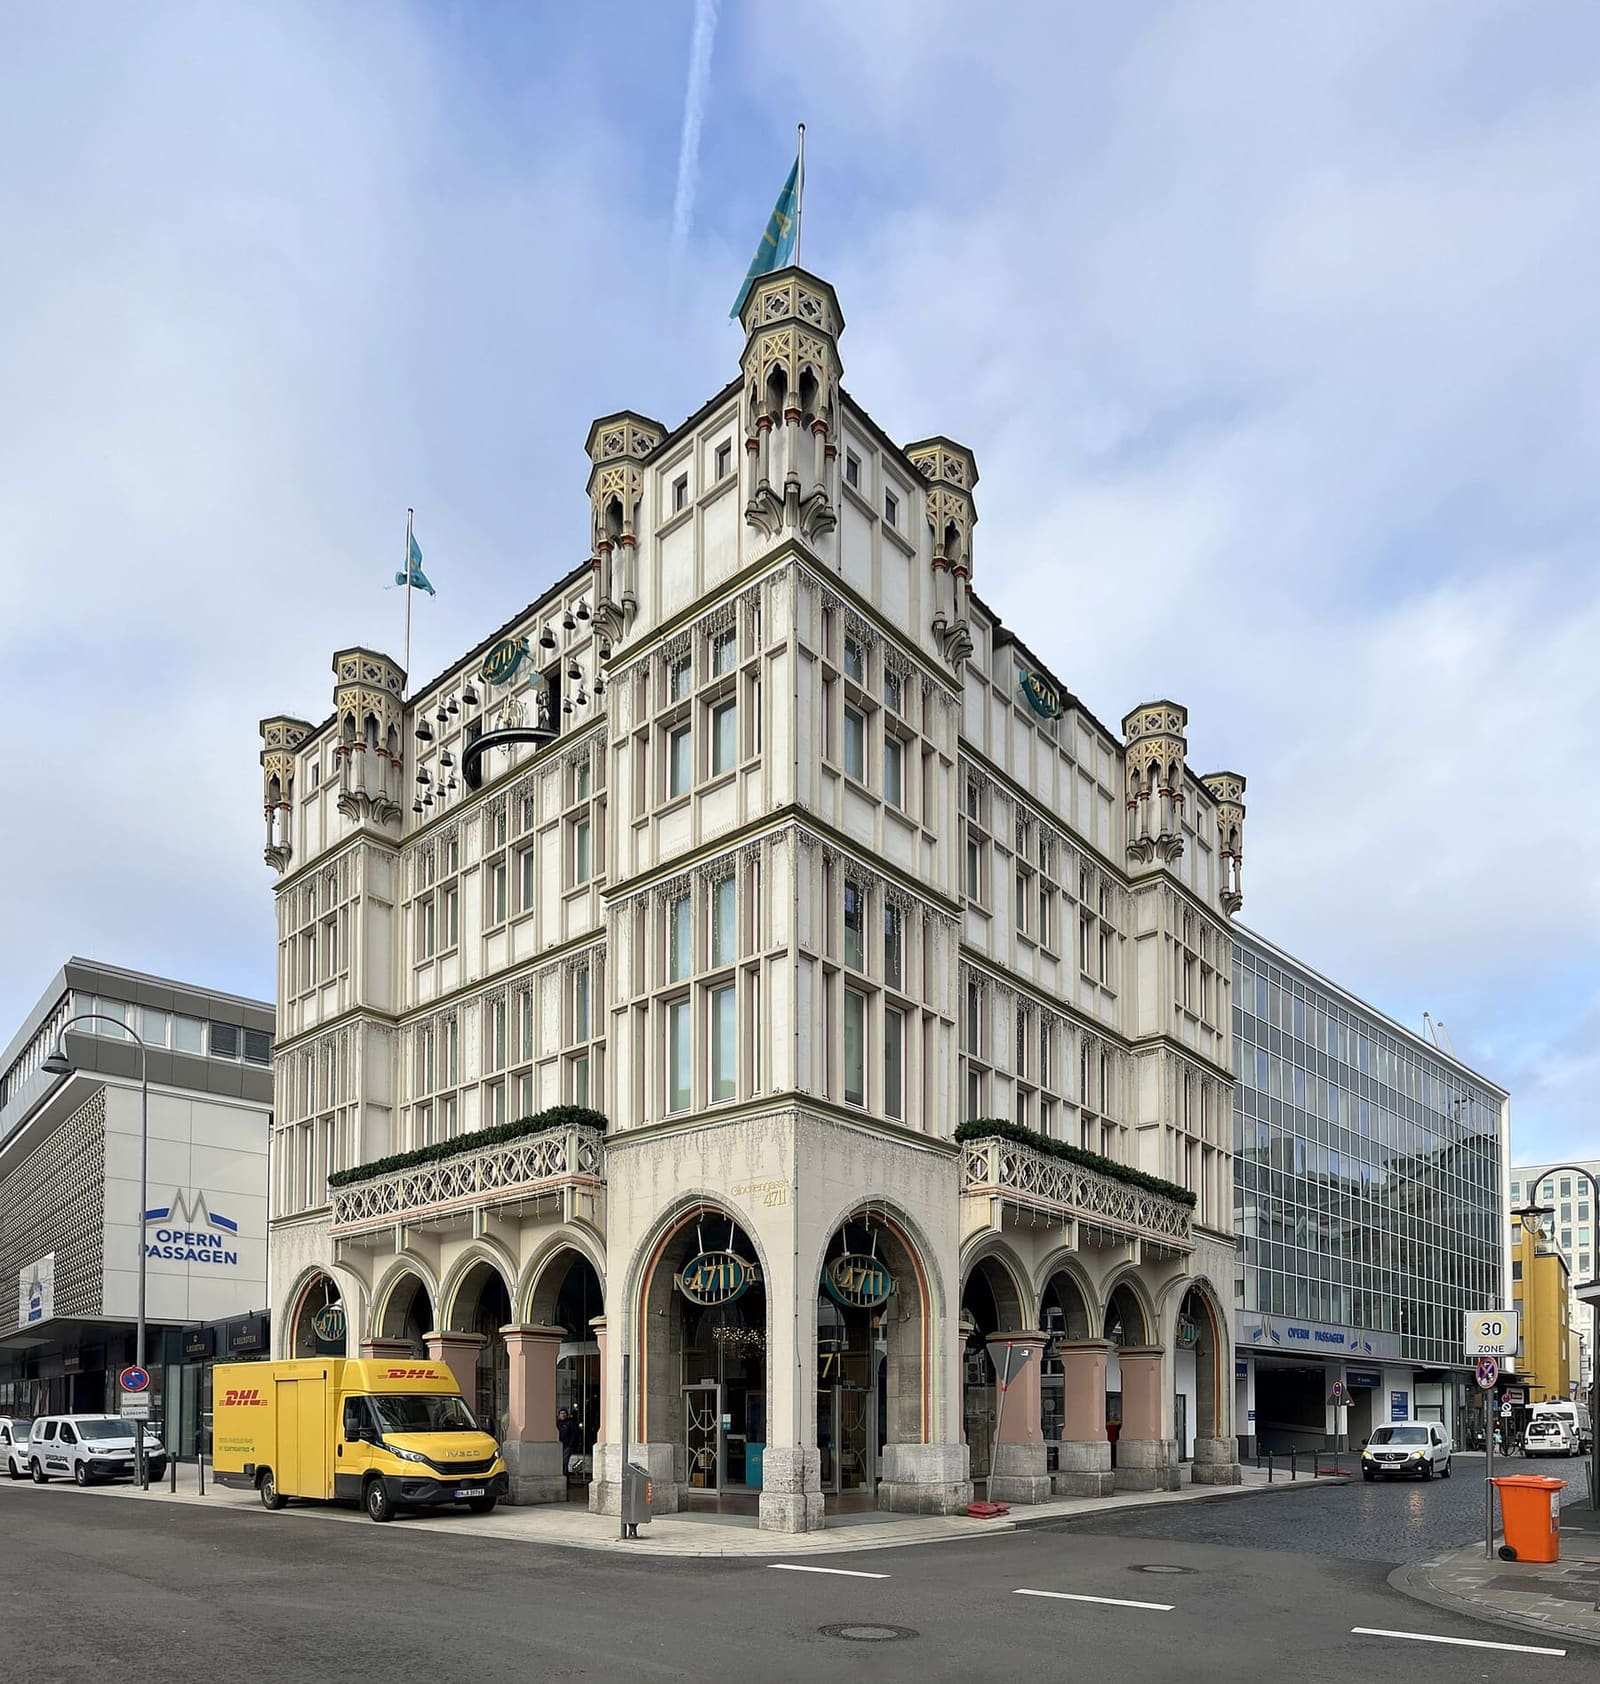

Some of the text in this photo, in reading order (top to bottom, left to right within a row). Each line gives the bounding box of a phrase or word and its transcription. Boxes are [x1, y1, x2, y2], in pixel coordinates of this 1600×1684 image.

[763, 1189, 786, 1207] 4711
[156, 1229, 222, 1248] OPERN
[143, 1244, 237, 1265] PASSAGEN
[689, 1262, 736, 1292] 4711
[840, 1265, 882, 1296] 4711
[1287, 1327, 1345, 1345] OPERN PASSAGEN
[1480, 1322, 1502, 1336] 30
[1478, 1344, 1505, 1353] ZONE
[387, 1369, 439, 1379] DHL
[225, 1389, 261, 1406] DHL
[444, 1450, 481, 1458] IVECO
